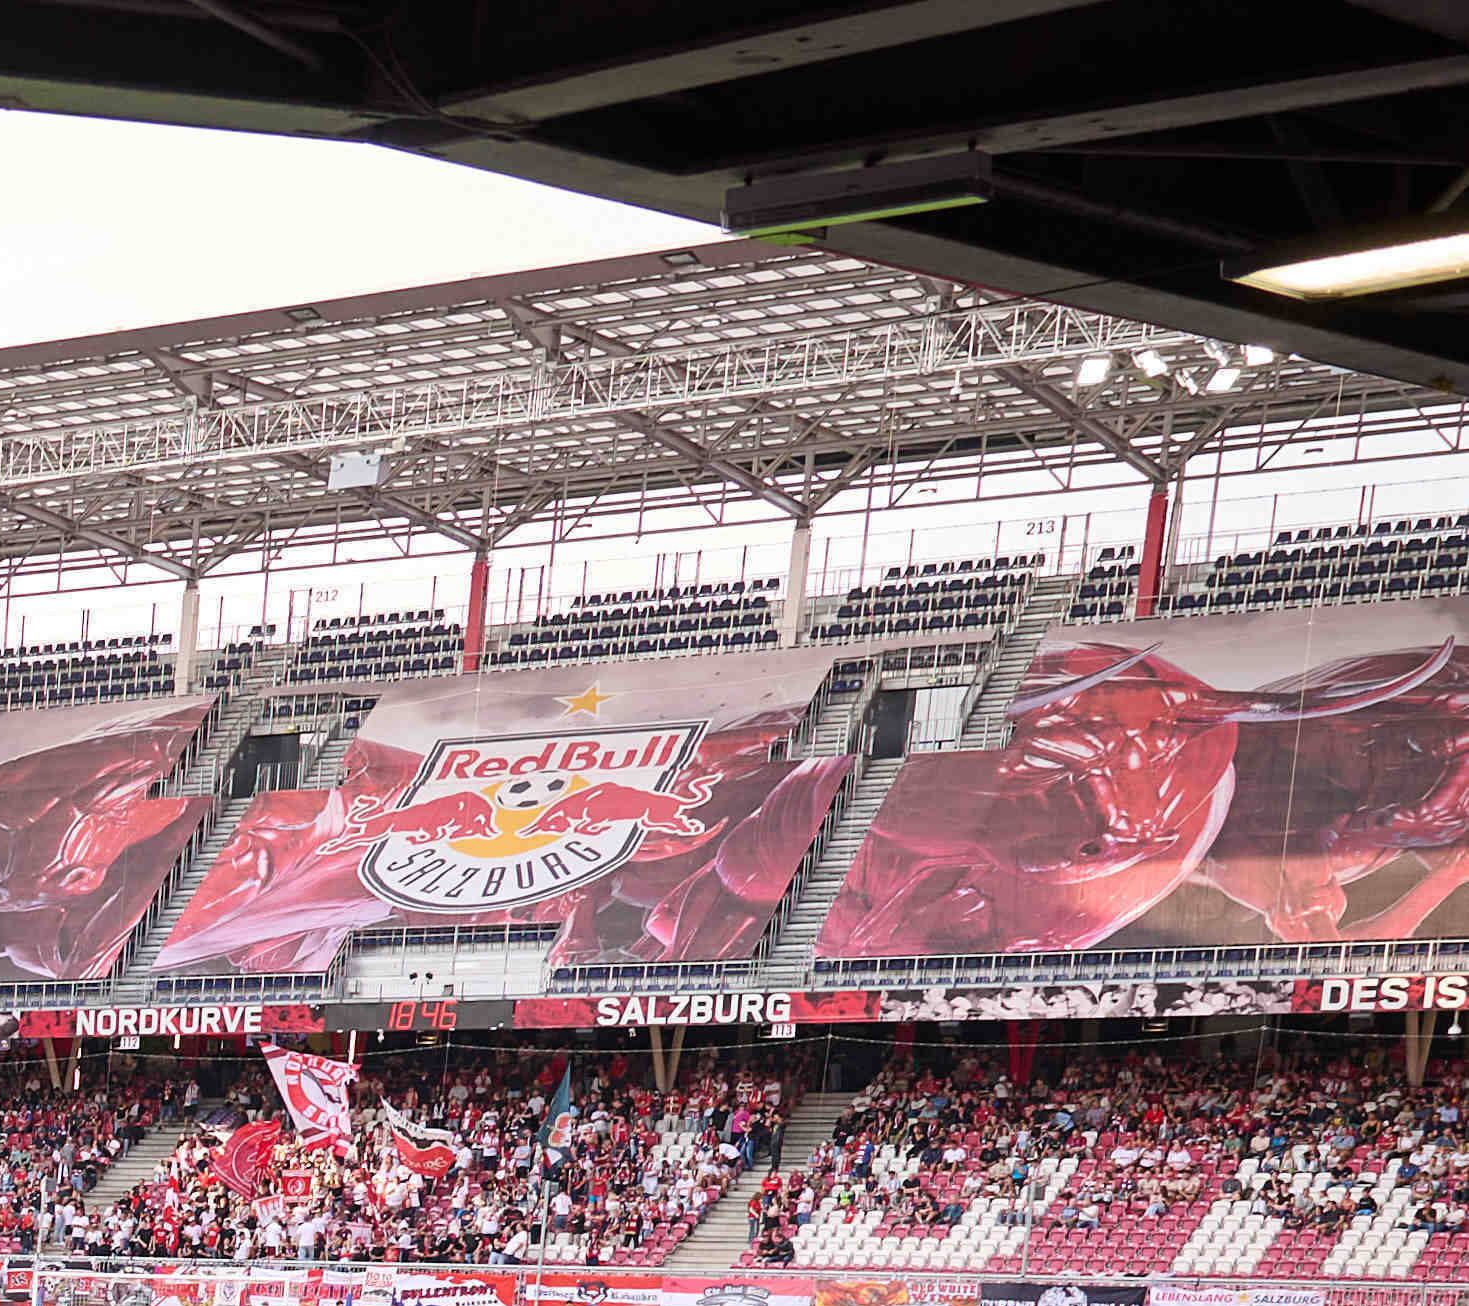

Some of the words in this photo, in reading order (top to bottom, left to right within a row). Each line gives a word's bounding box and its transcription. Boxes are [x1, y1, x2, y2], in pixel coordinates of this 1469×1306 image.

[1026, 520, 1055, 535] 213
[438, 742, 556, 781] Red
[557, 735, 680, 772] Bull
[389, 840, 602, 900] SALZBURG
[596, 993, 791, 1026] SALZBURG
[1320, 978, 1409, 1011] DES
[1422, 976, 1469, 1008] IS
[76, 1006, 262, 1037] NORDKURVE
[1155, 1290, 1233, 1304] LEBENSLANG
[1253, 1293, 1321, 1305] SALZBURG
